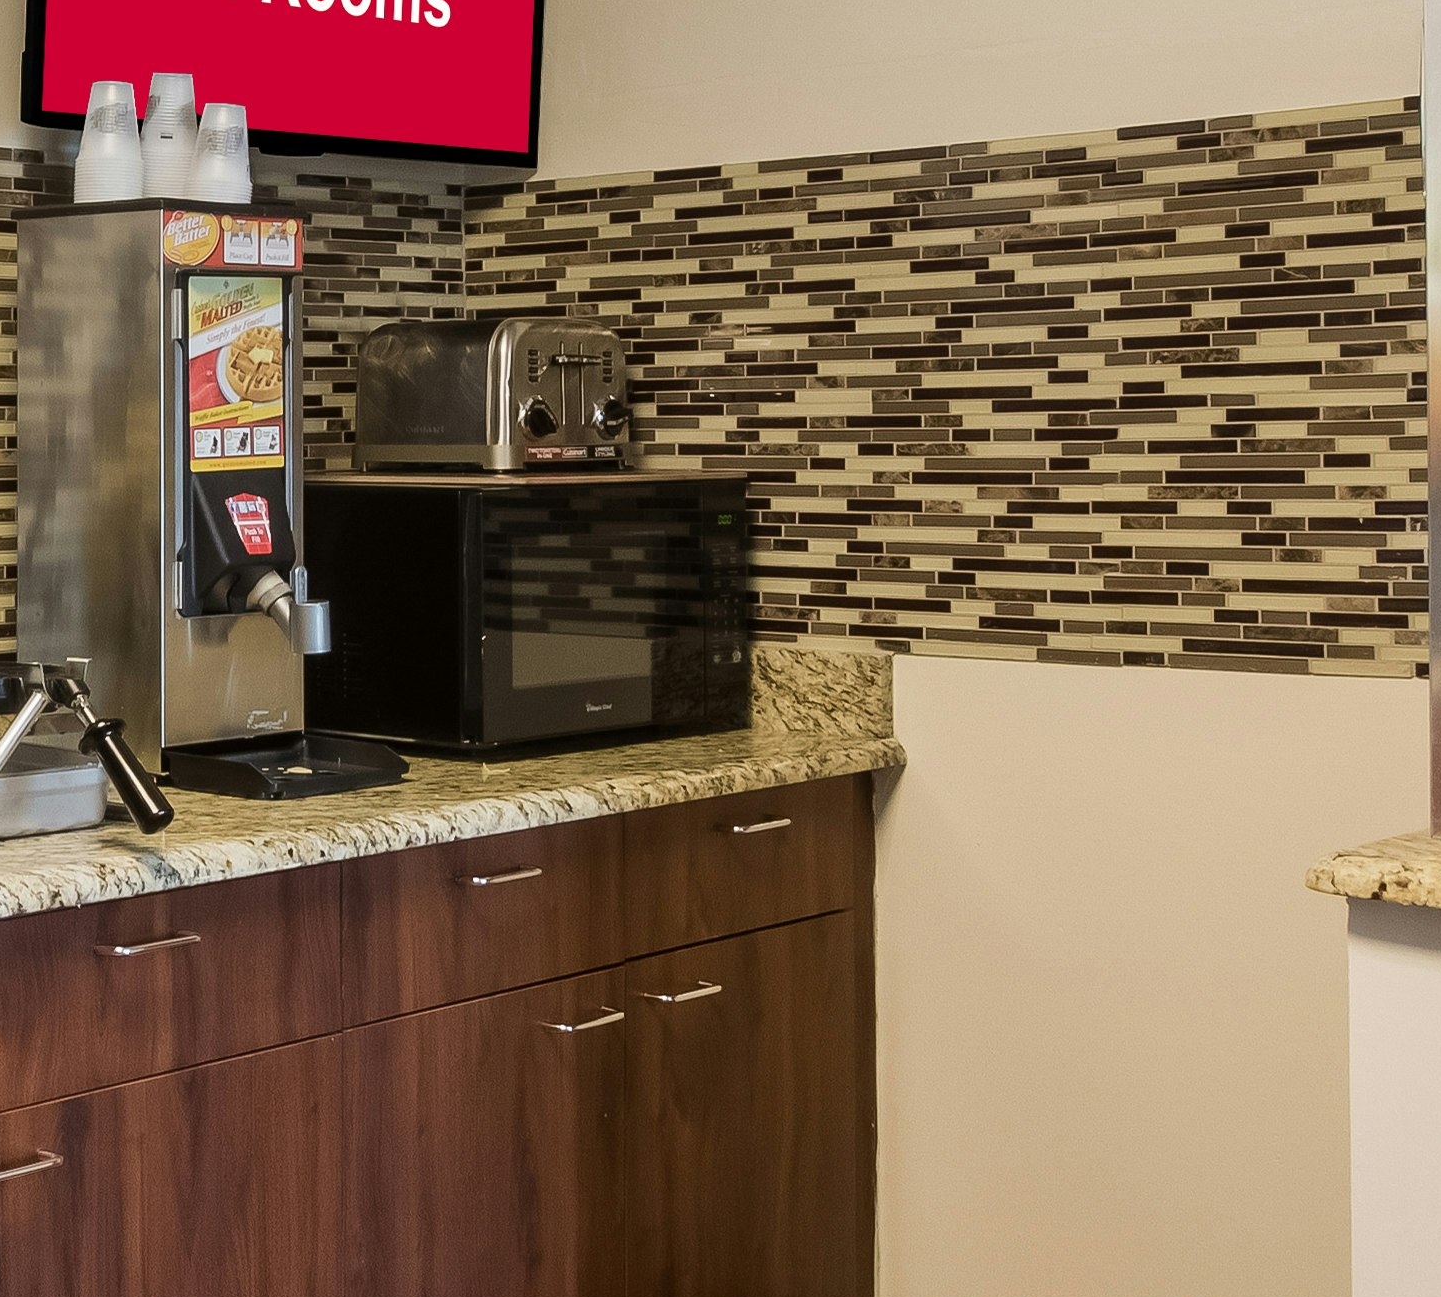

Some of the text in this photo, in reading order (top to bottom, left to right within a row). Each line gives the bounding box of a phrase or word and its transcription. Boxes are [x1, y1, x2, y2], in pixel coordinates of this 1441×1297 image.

[166, 213, 205, 236] Better
[174, 226, 211, 246] Batter
[201, 301, 243, 329] MALTED
